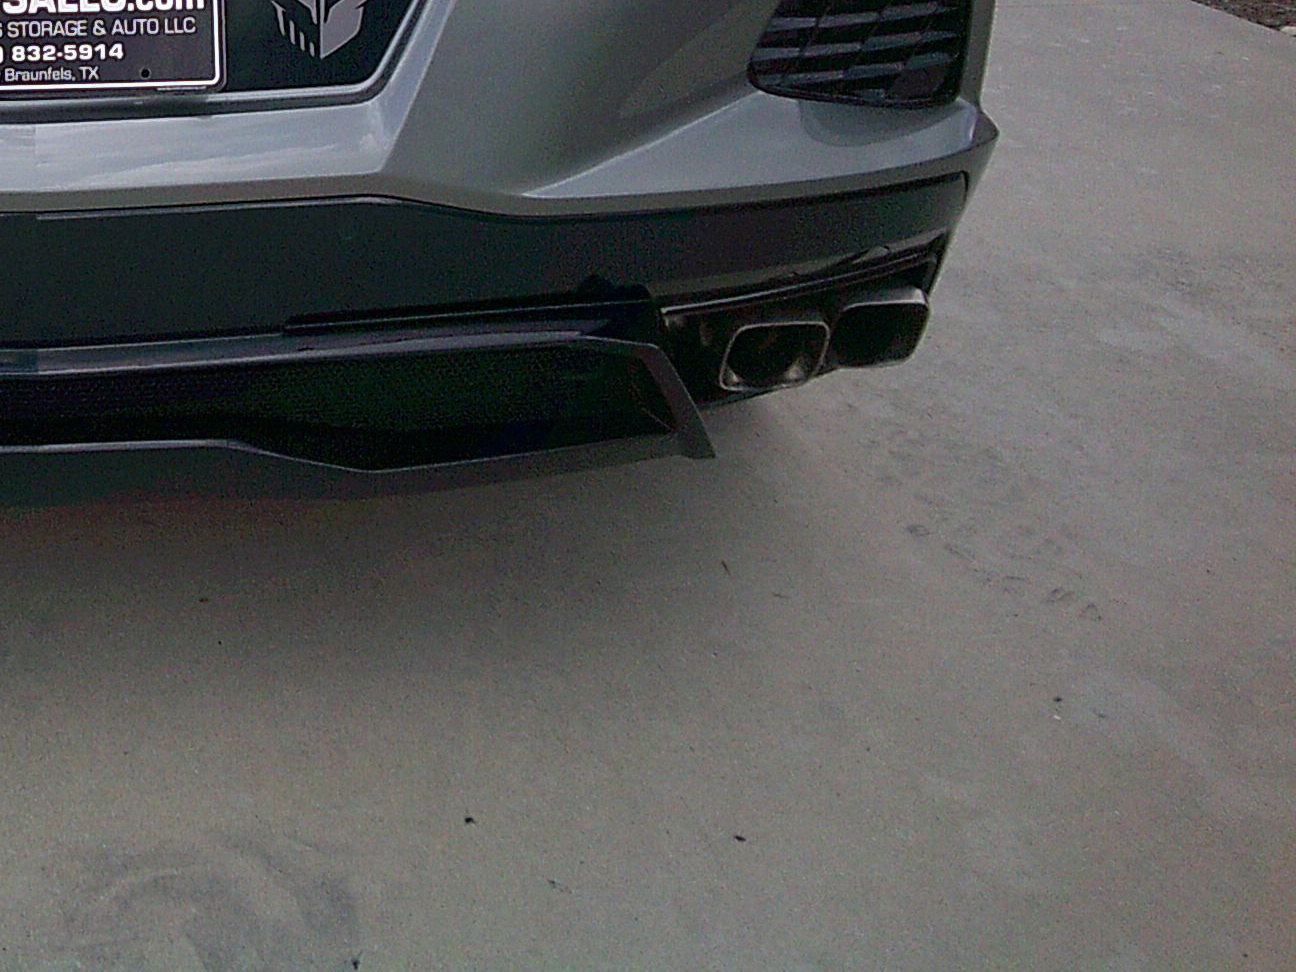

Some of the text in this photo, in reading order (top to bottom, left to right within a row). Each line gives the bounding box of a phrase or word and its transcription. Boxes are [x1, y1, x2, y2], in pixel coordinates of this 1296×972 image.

[7, 20, 88, 37] STORAGE
[92, 19, 107, 35] &
[111, 18, 160, 35] AUTO
[164, 16, 197, 34] LLC
[11, 43, 124, 62] 832-5914
[4, 66, 76, 82] Braunfels,
[79, 65, 99, 80] TX
